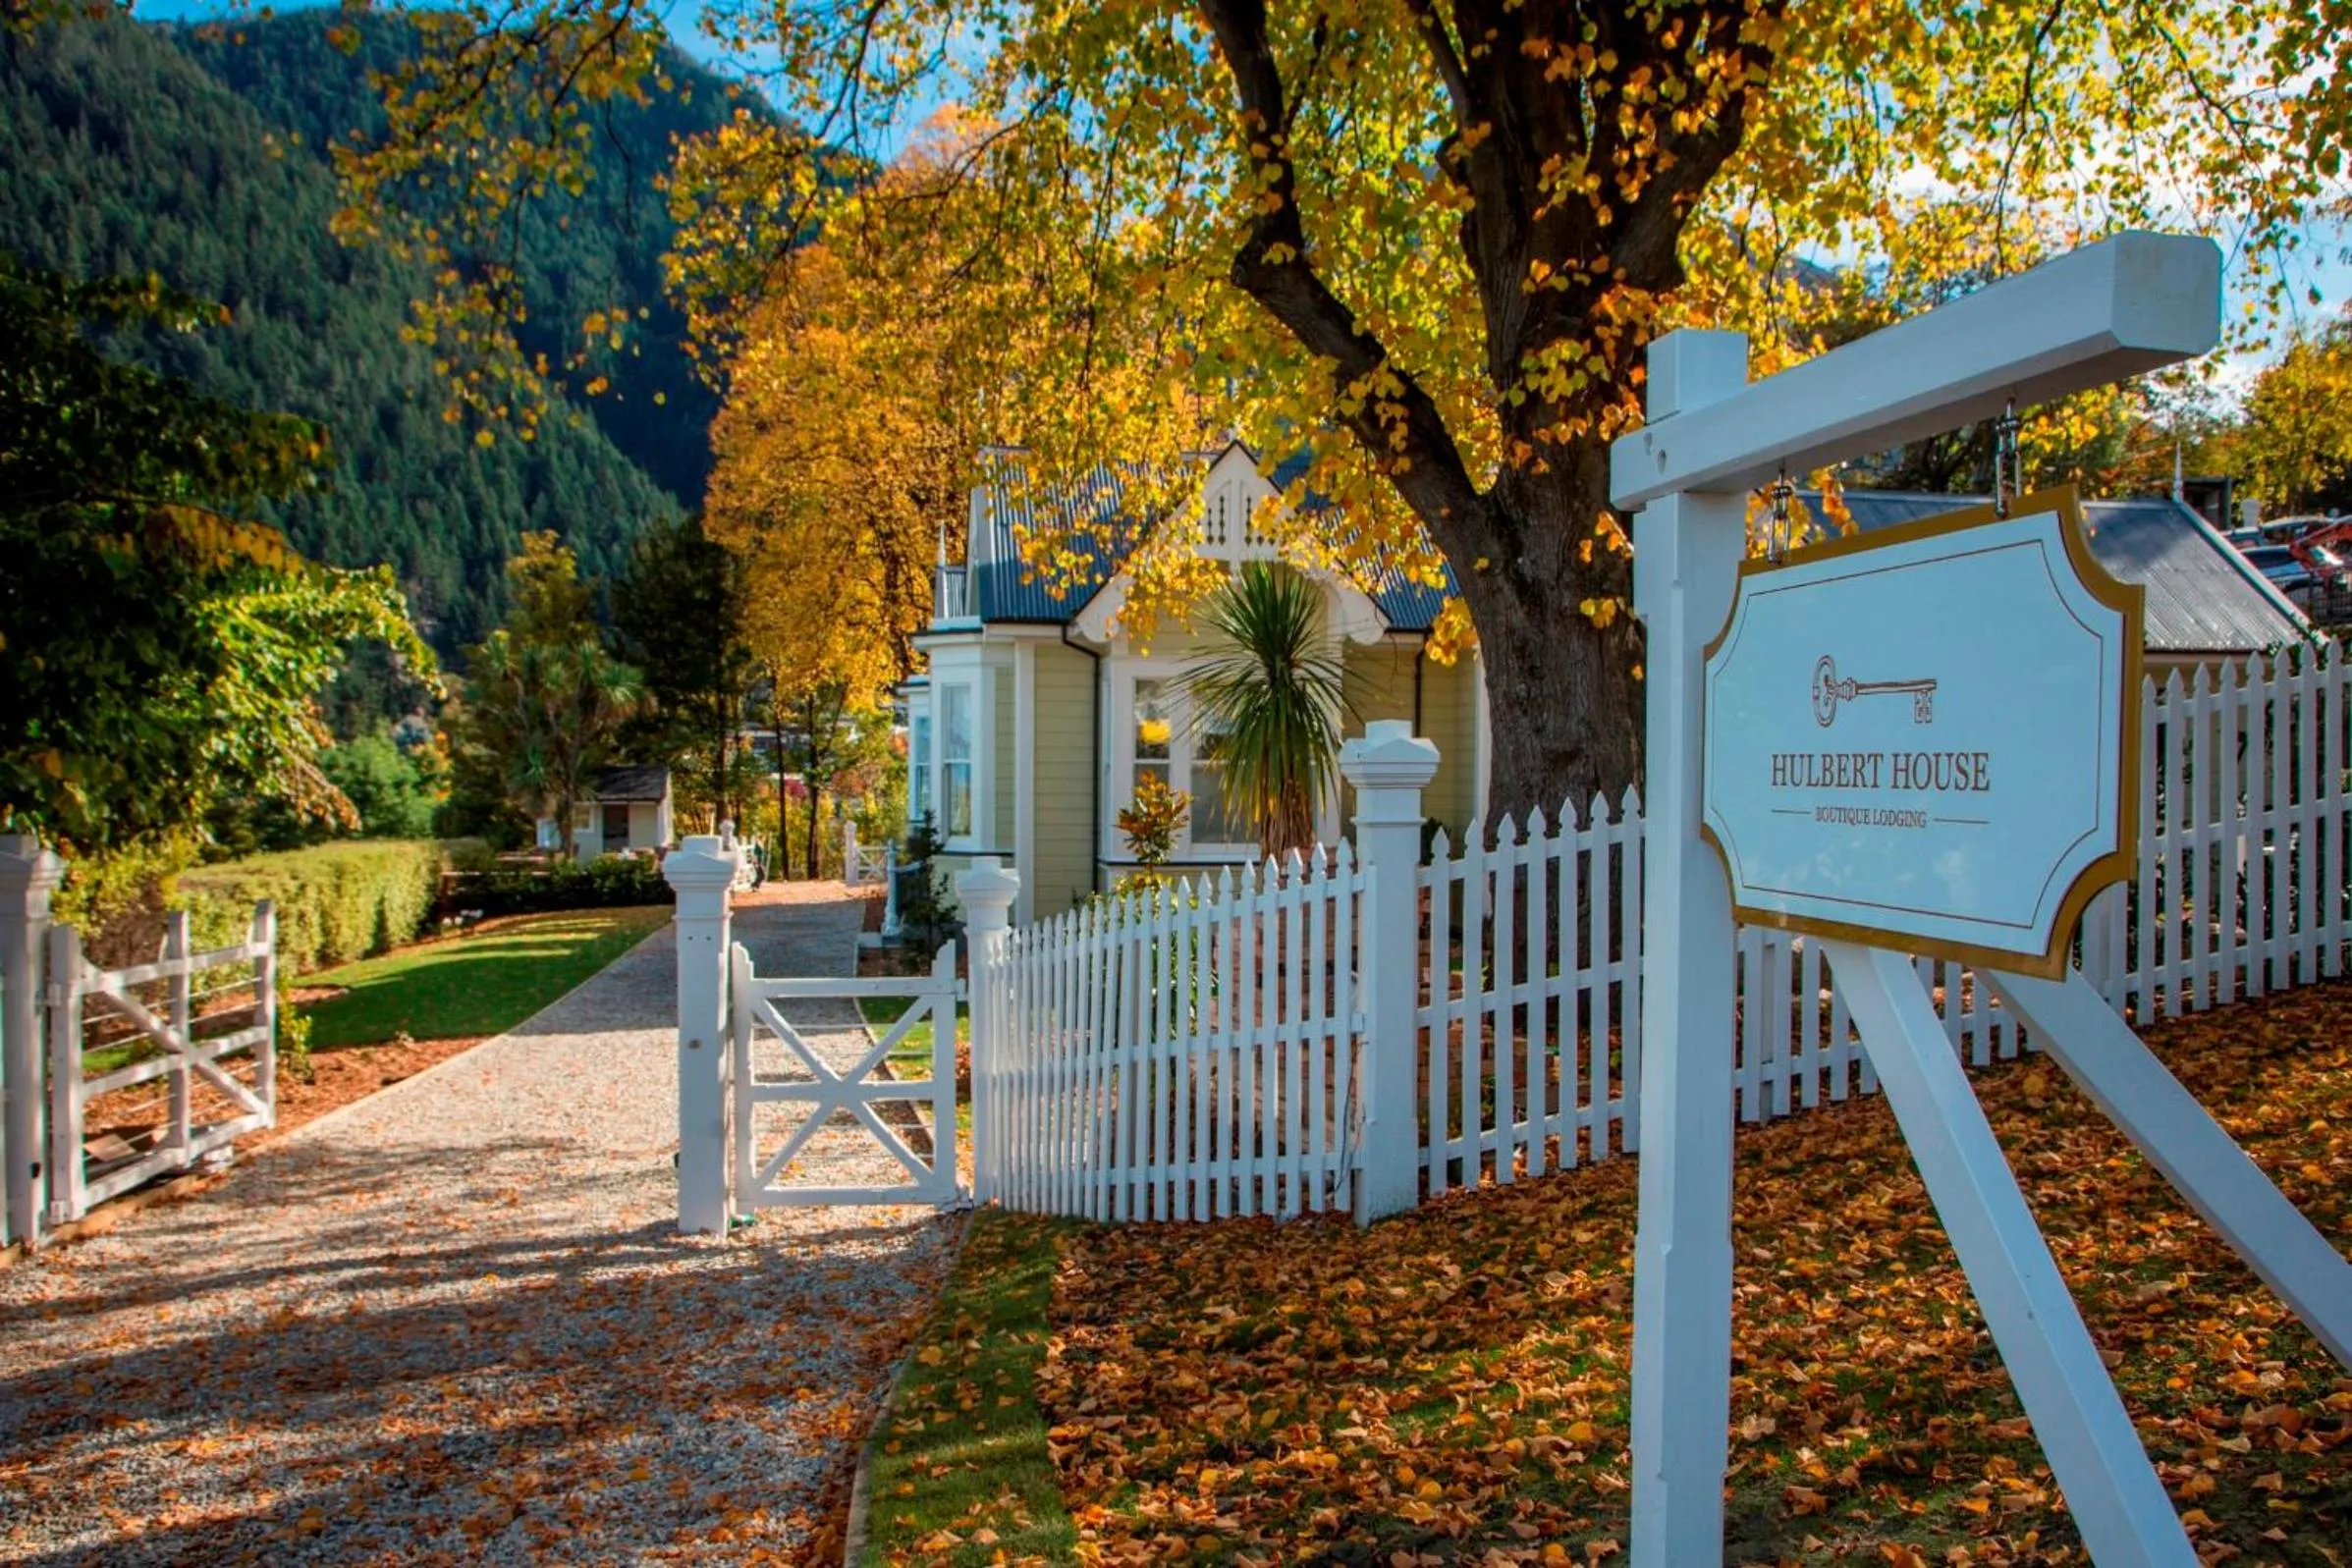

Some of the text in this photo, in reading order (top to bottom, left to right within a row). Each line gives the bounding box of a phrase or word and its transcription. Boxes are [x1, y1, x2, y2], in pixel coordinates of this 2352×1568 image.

[1771, 752, 1990, 791] HULBERT HOUSE
[1815, 806, 1928, 829] BOUTIQUE LODGING
